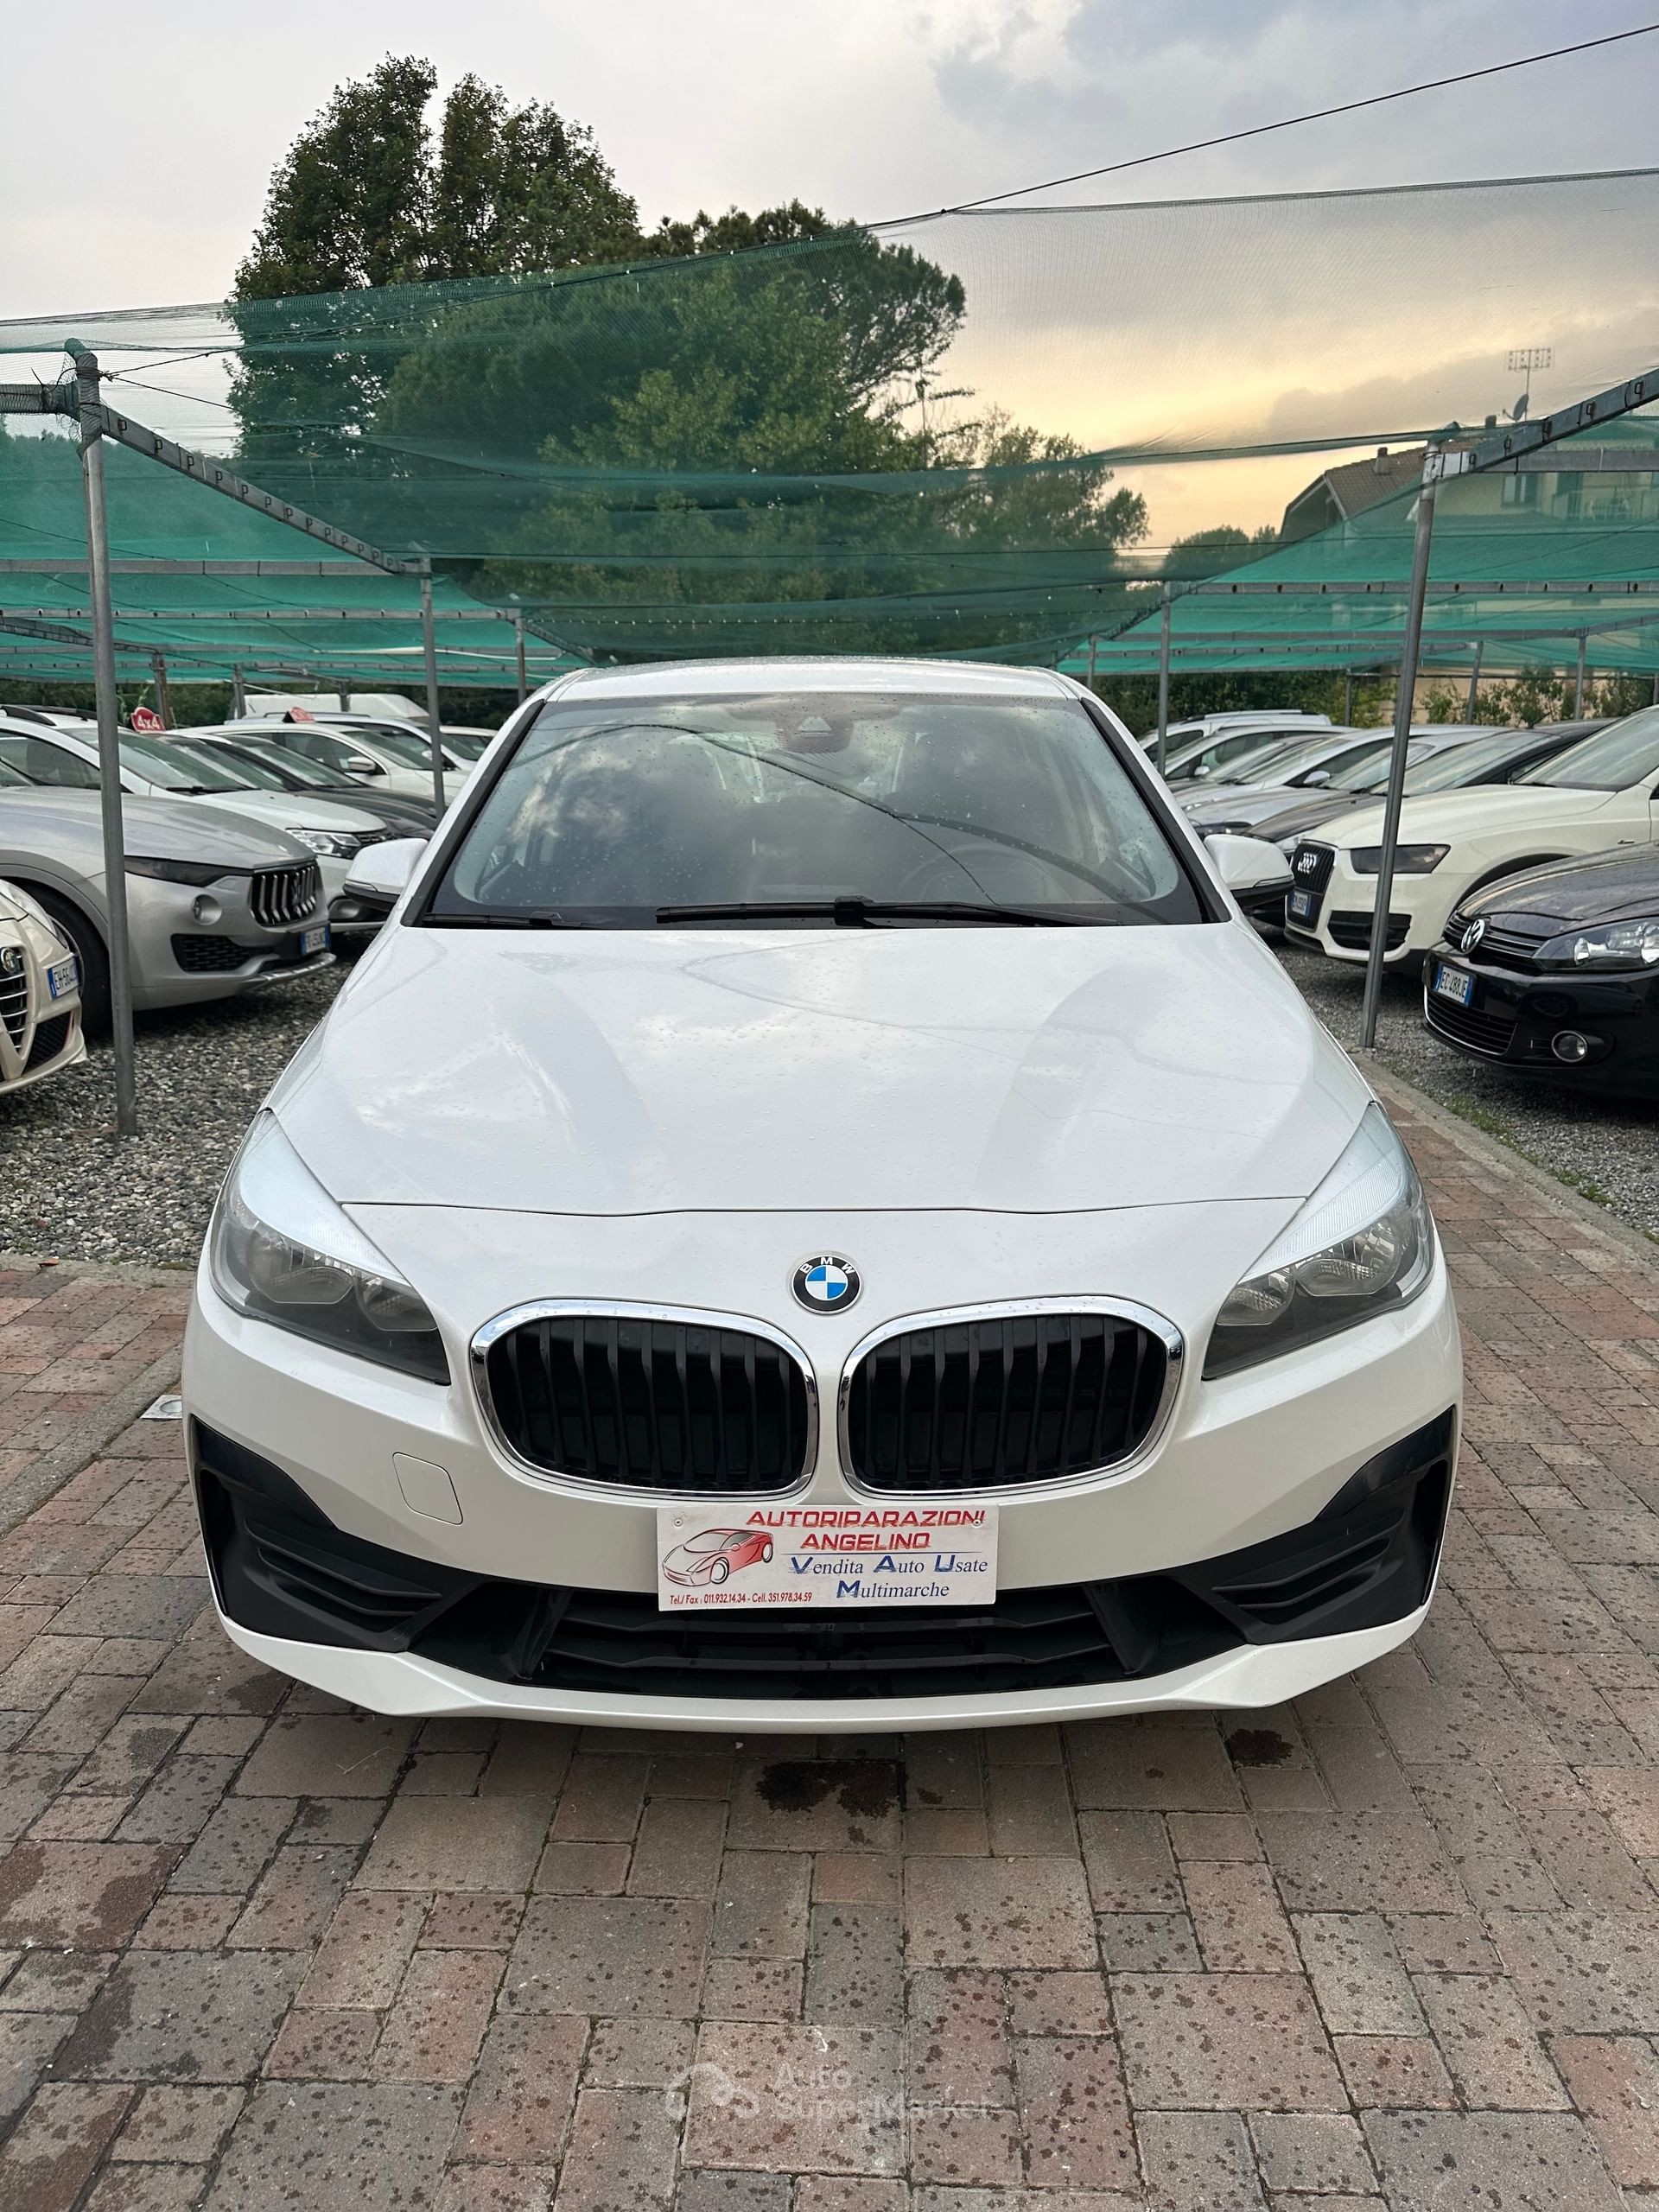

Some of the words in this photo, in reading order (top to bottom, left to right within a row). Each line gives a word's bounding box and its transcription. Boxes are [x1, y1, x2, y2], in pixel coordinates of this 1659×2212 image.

[138, 715, 160, 730] 4x4
[799, 1256, 855, 1274] BMW
[746, 1510, 985, 1528] AUTORIPARAZIONI
[800, 1532, 931, 1551] ANGELINO
[790, 1556, 864, 1574] Vendita
[873, 1554, 925, 1573] Auto
[934, 1554, 988, 1573] Usate
[836, 1580, 950, 1599] Multimarche
